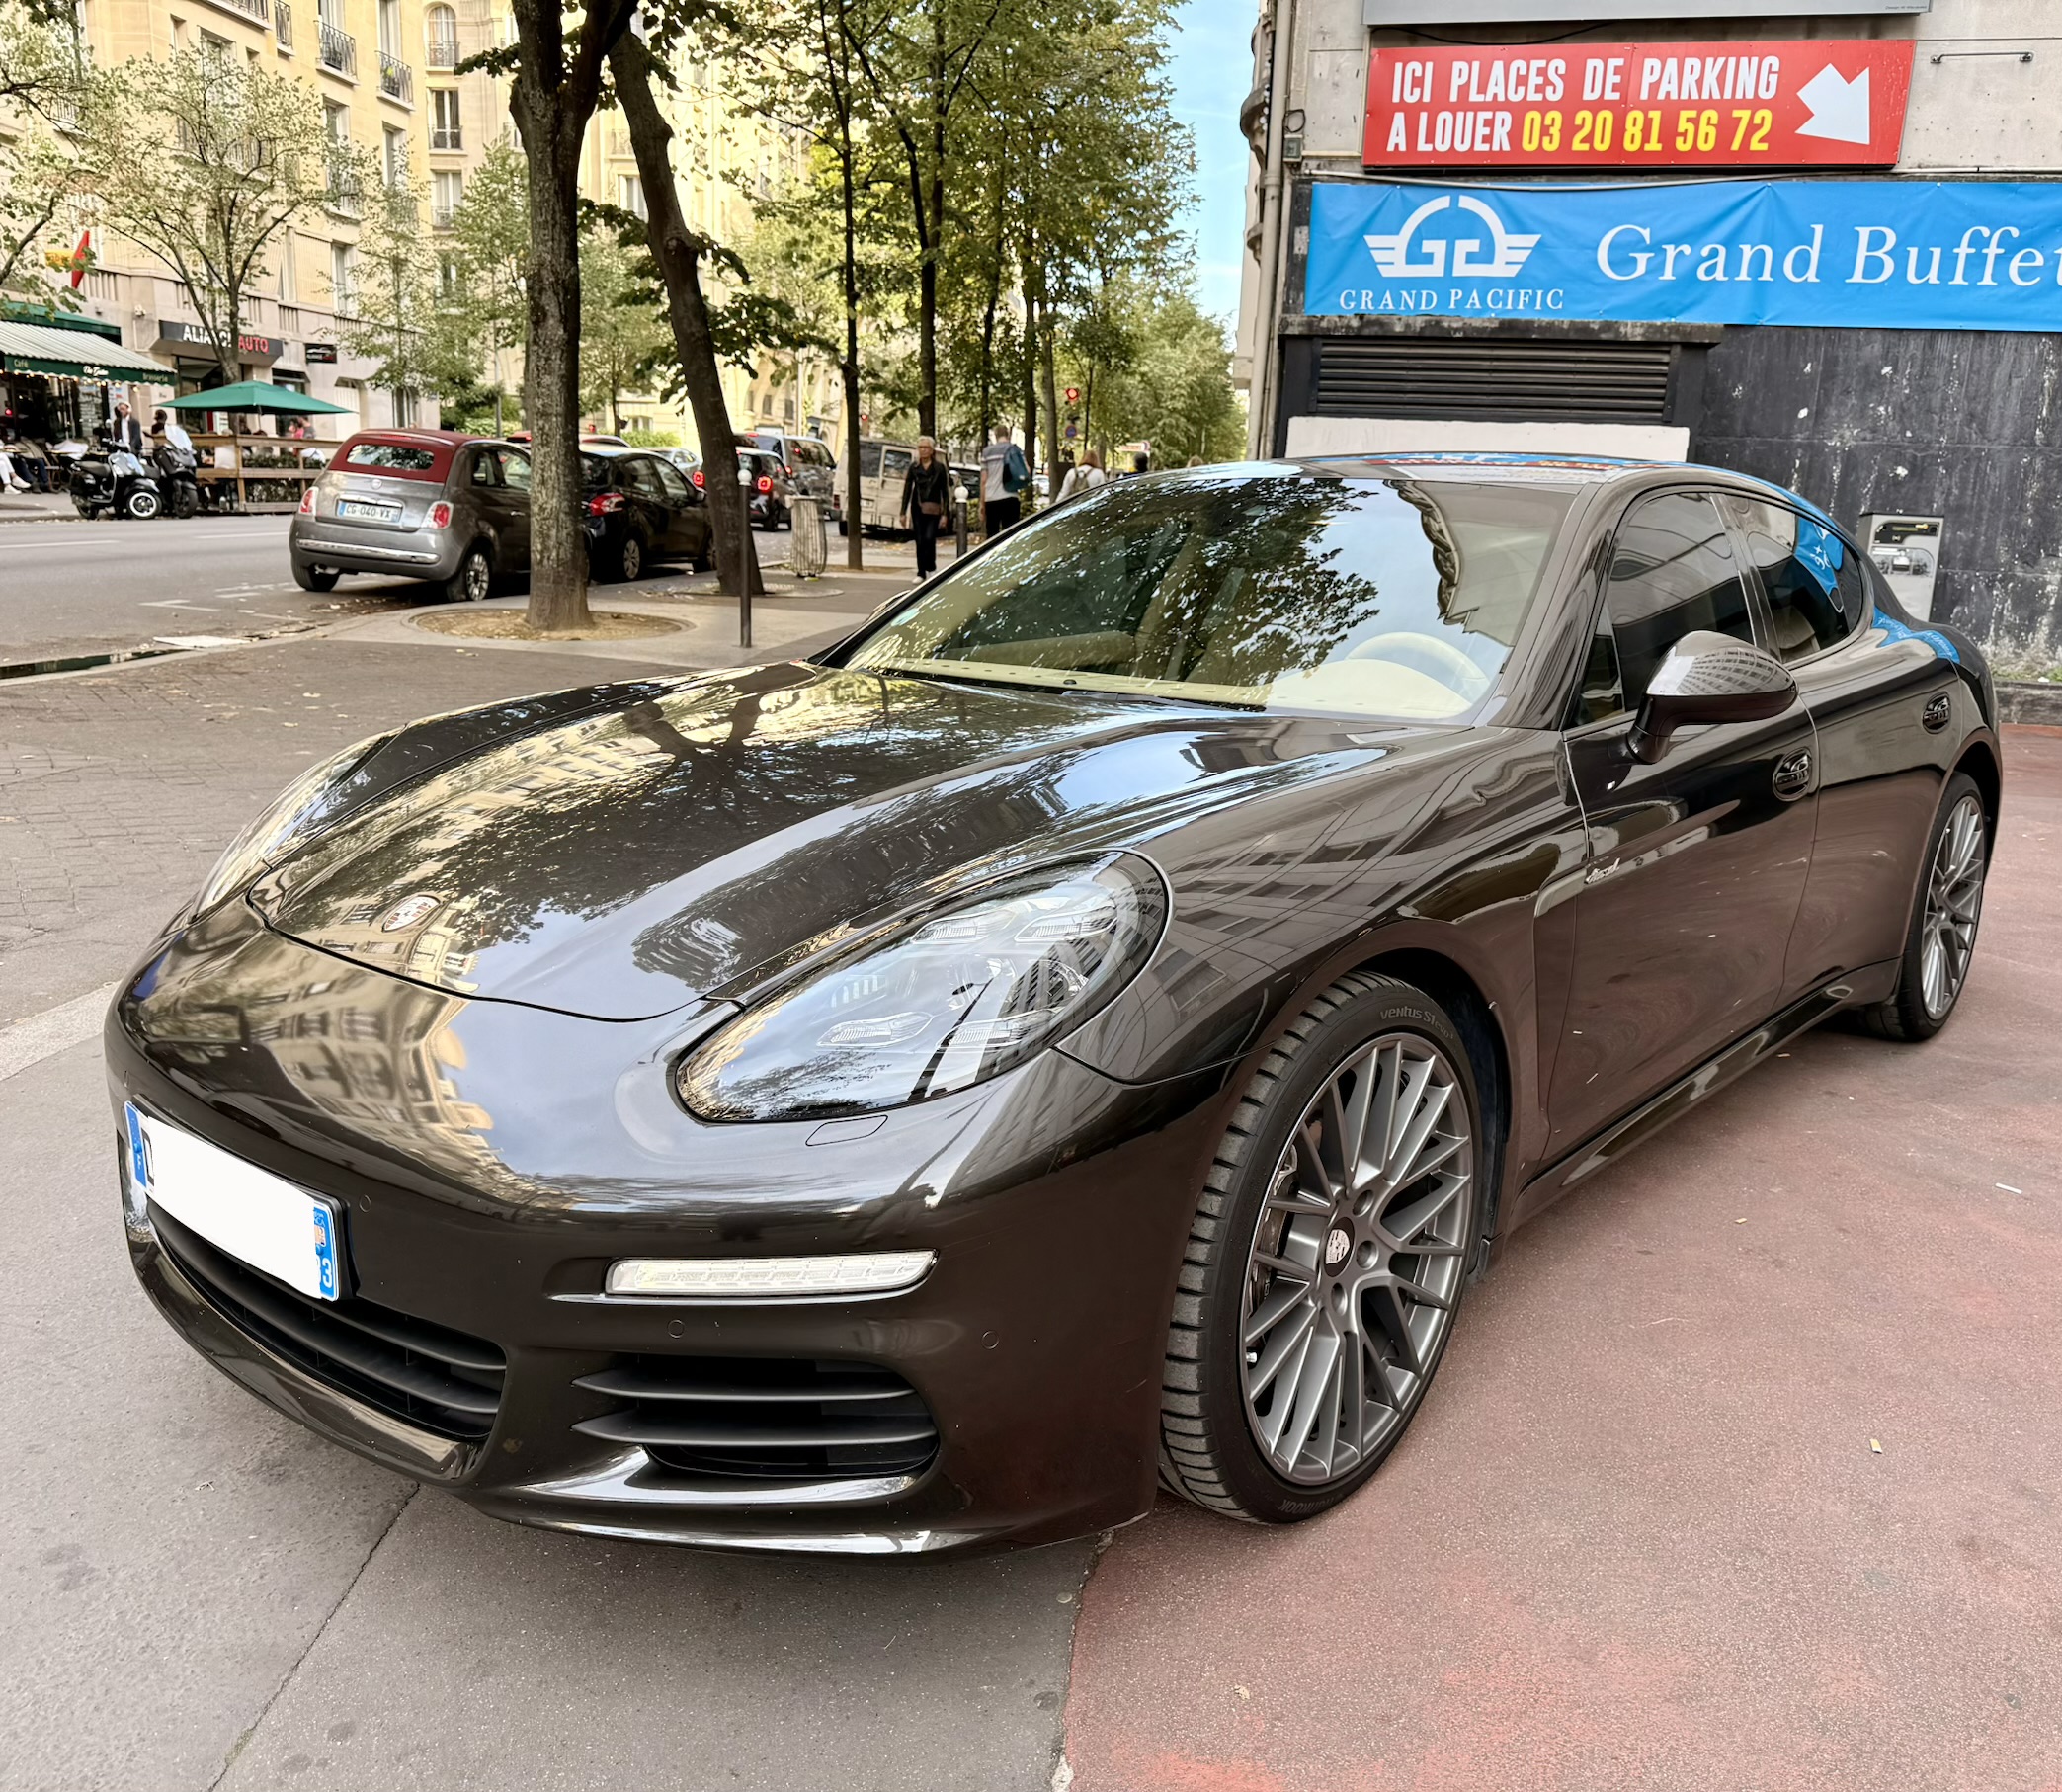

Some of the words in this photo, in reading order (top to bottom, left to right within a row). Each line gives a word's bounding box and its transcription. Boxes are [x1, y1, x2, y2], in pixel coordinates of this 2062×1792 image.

[1391, 60, 1434, 104] ICI
[1448, 58, 1567, 103] PLACES
[1582, 57, 1625, 101] DE
[1639, 55, 1780, 101] PARKING
[1386, 111, 1407, 152] A
[1416, 110, 1513, 153] LOUER
[1521, 109, 1563, 152] 03
[1571, 109, 1614, 152] 20
[1622, 109, 1663, 152] 81
[1675, 108, 1720, 152] 56
[1730, 108, 1773, 151] 72
[1597, 224, 1825, 283] Grand
[1339, 289, 1438, 310] GRAND
[1449, 288, 1564, 310] PACIFIC
[238, 335, 269, 353] AUTO
